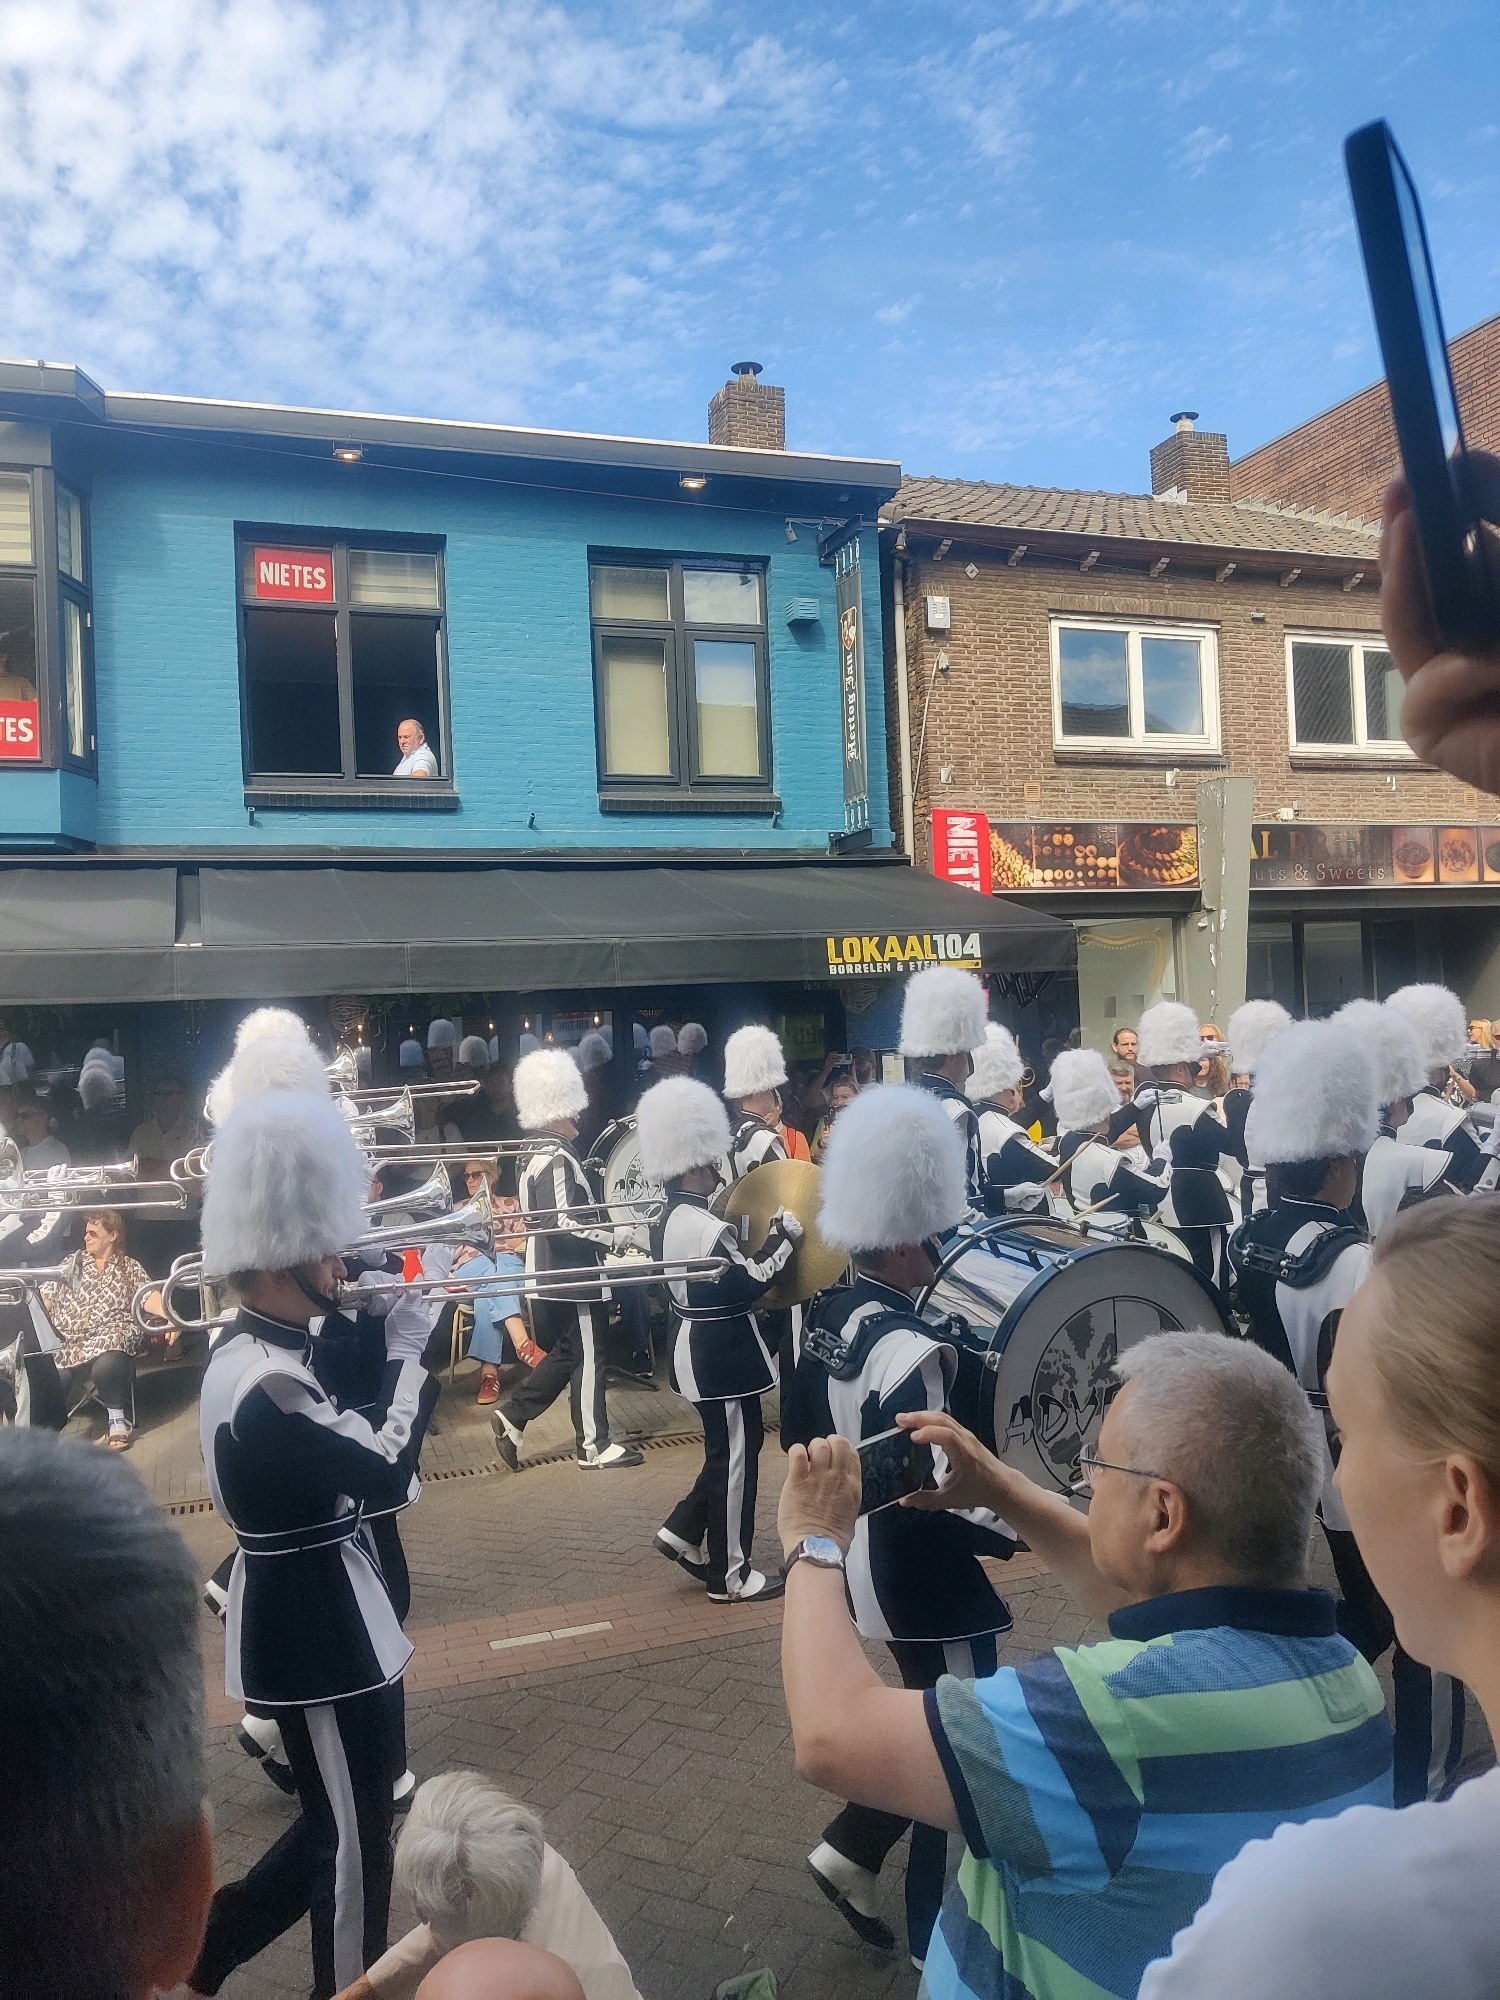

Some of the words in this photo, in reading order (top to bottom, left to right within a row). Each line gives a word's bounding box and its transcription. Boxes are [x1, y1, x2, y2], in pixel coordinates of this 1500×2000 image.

[259, 560, 327, 590] NIETES
[845, 651, 856, 692] Jan
[847, 691, 859, 763] Hertog
[1294, 863, 1309, 881] &
[1316, 863, 1386, 881] Sweets
[828, 961, 892, 975] BORRELEN
[896, 961, 904, 972] &
